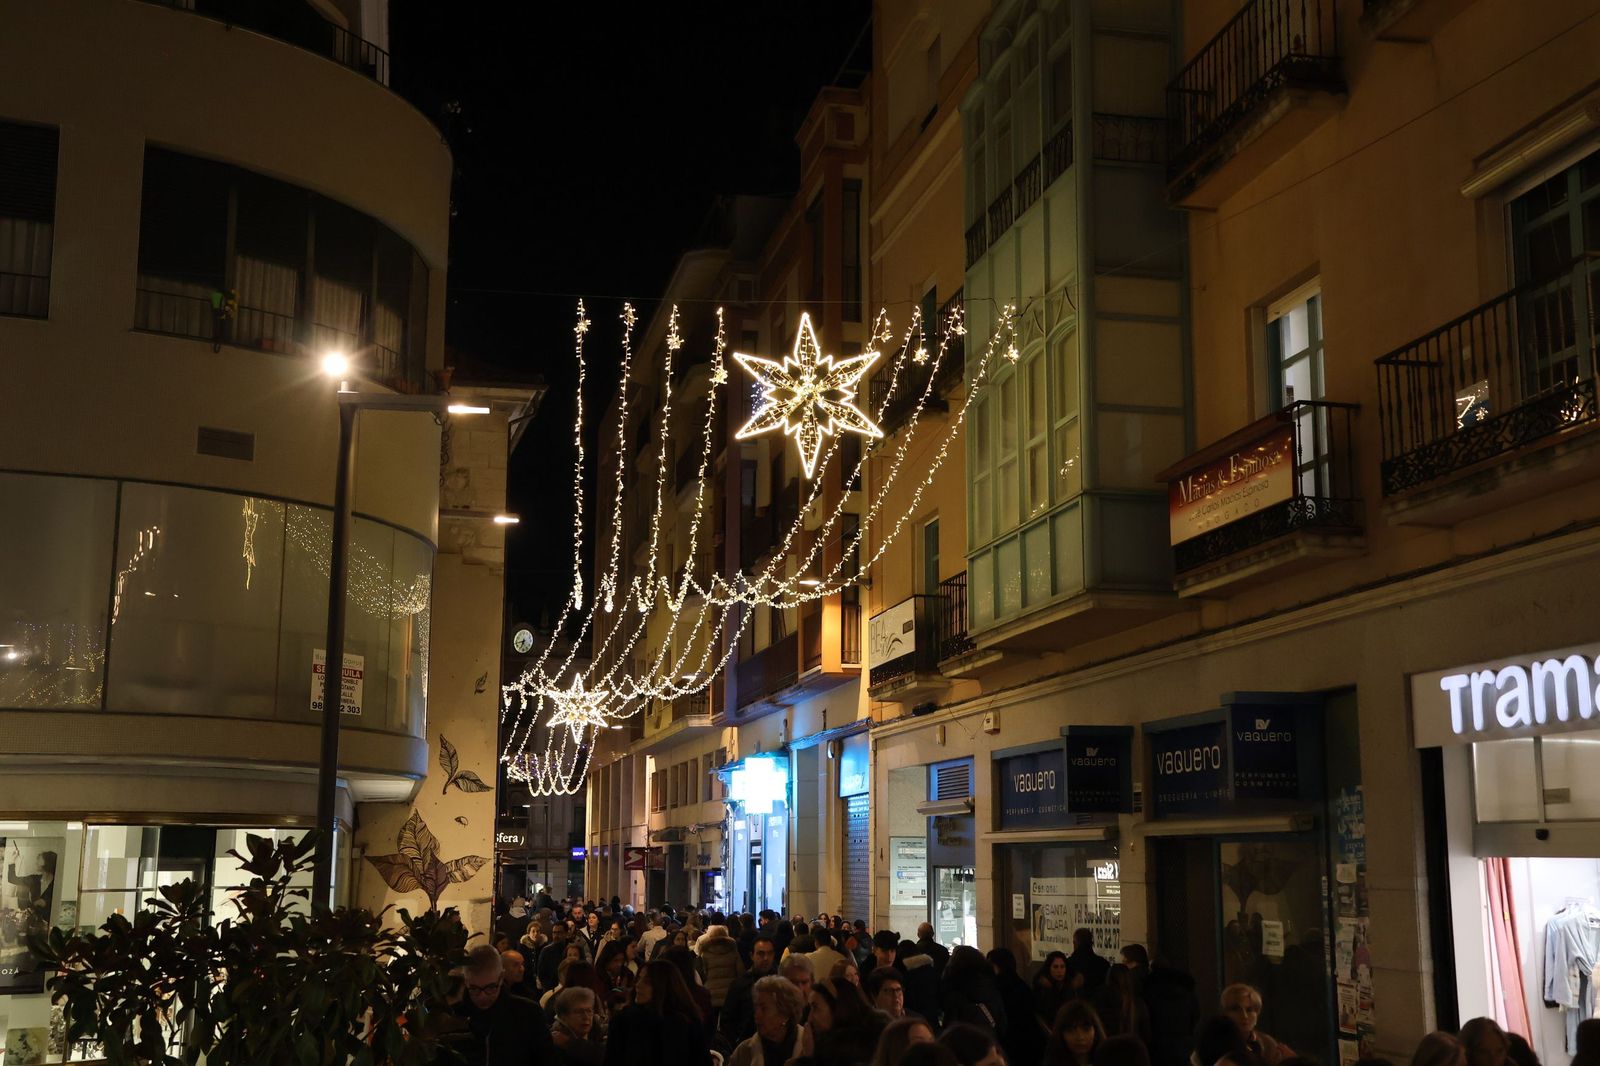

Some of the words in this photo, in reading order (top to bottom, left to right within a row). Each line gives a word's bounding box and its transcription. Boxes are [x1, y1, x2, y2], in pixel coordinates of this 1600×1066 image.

[1440, 654, 1600, 735] Tram
[347, 705, 361, 714] 303
[1045, 904, 1068, 917] SANTA
[1046, 919, 1069, 932] CLARA
